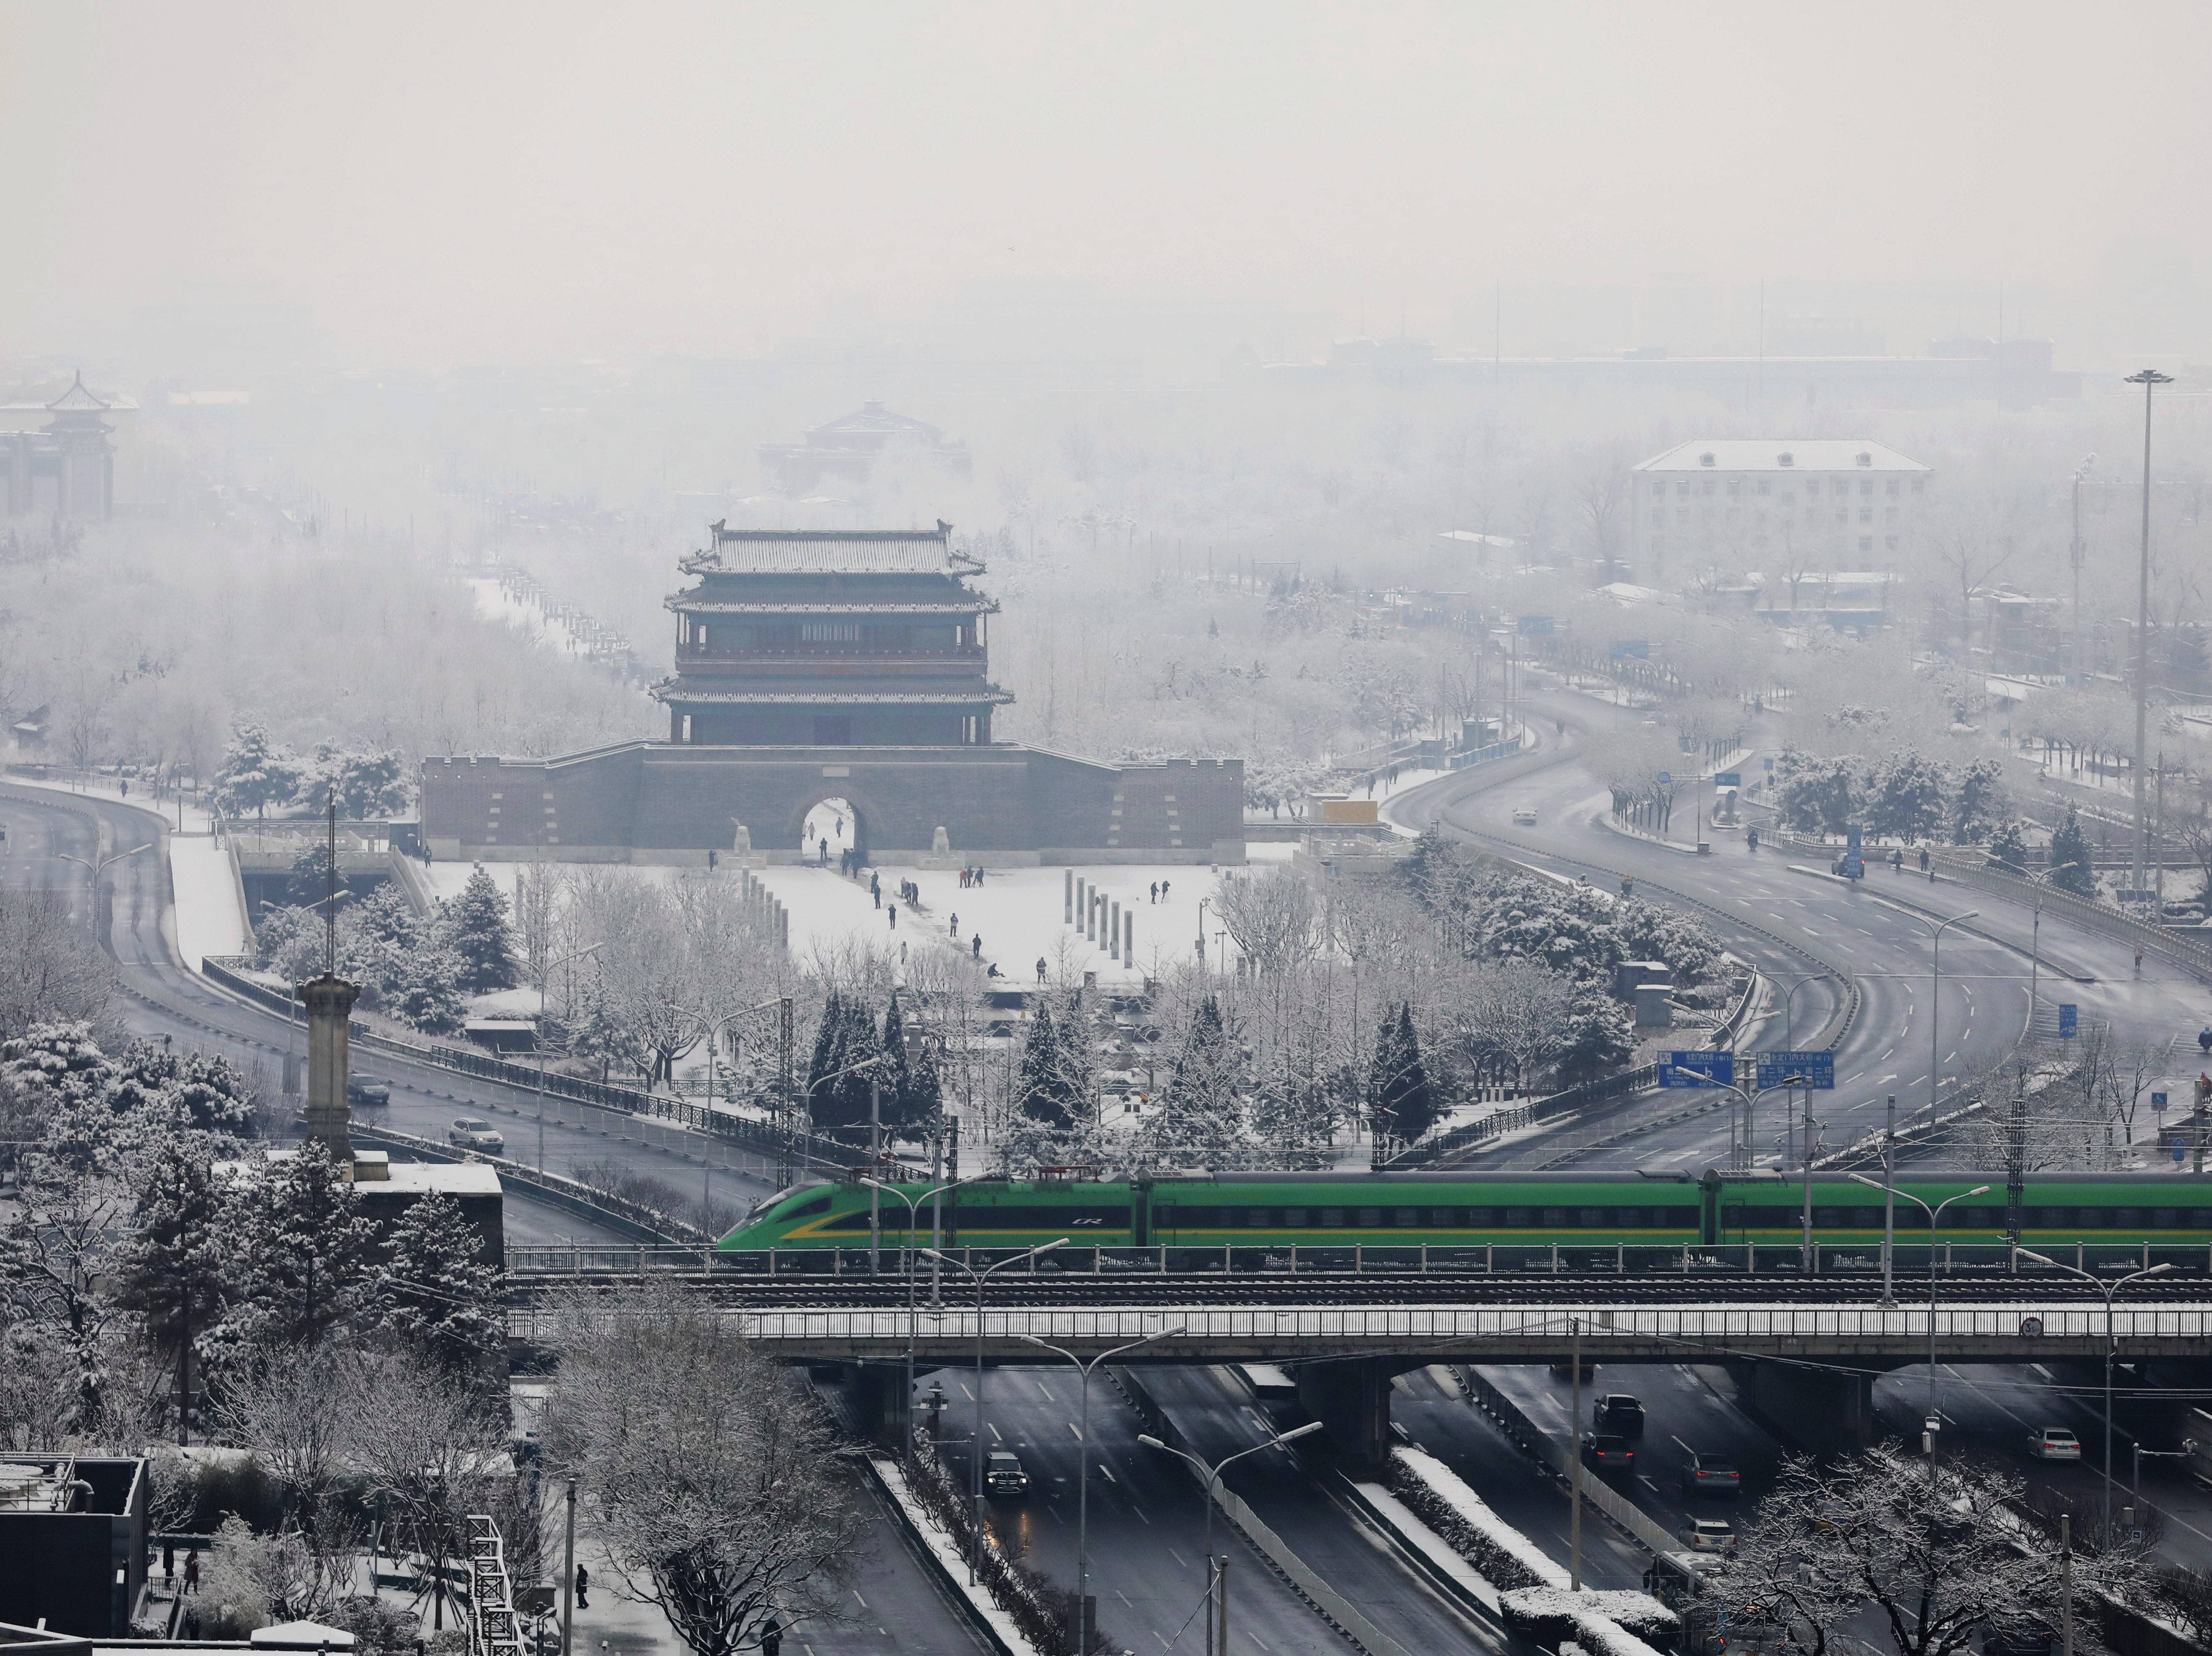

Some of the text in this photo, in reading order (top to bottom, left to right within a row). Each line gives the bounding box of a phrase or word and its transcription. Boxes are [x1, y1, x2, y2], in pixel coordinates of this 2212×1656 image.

[1758, 1066, 1786, 1075] 南二环
[1806, 1067, 1833, 1076] 南二环
